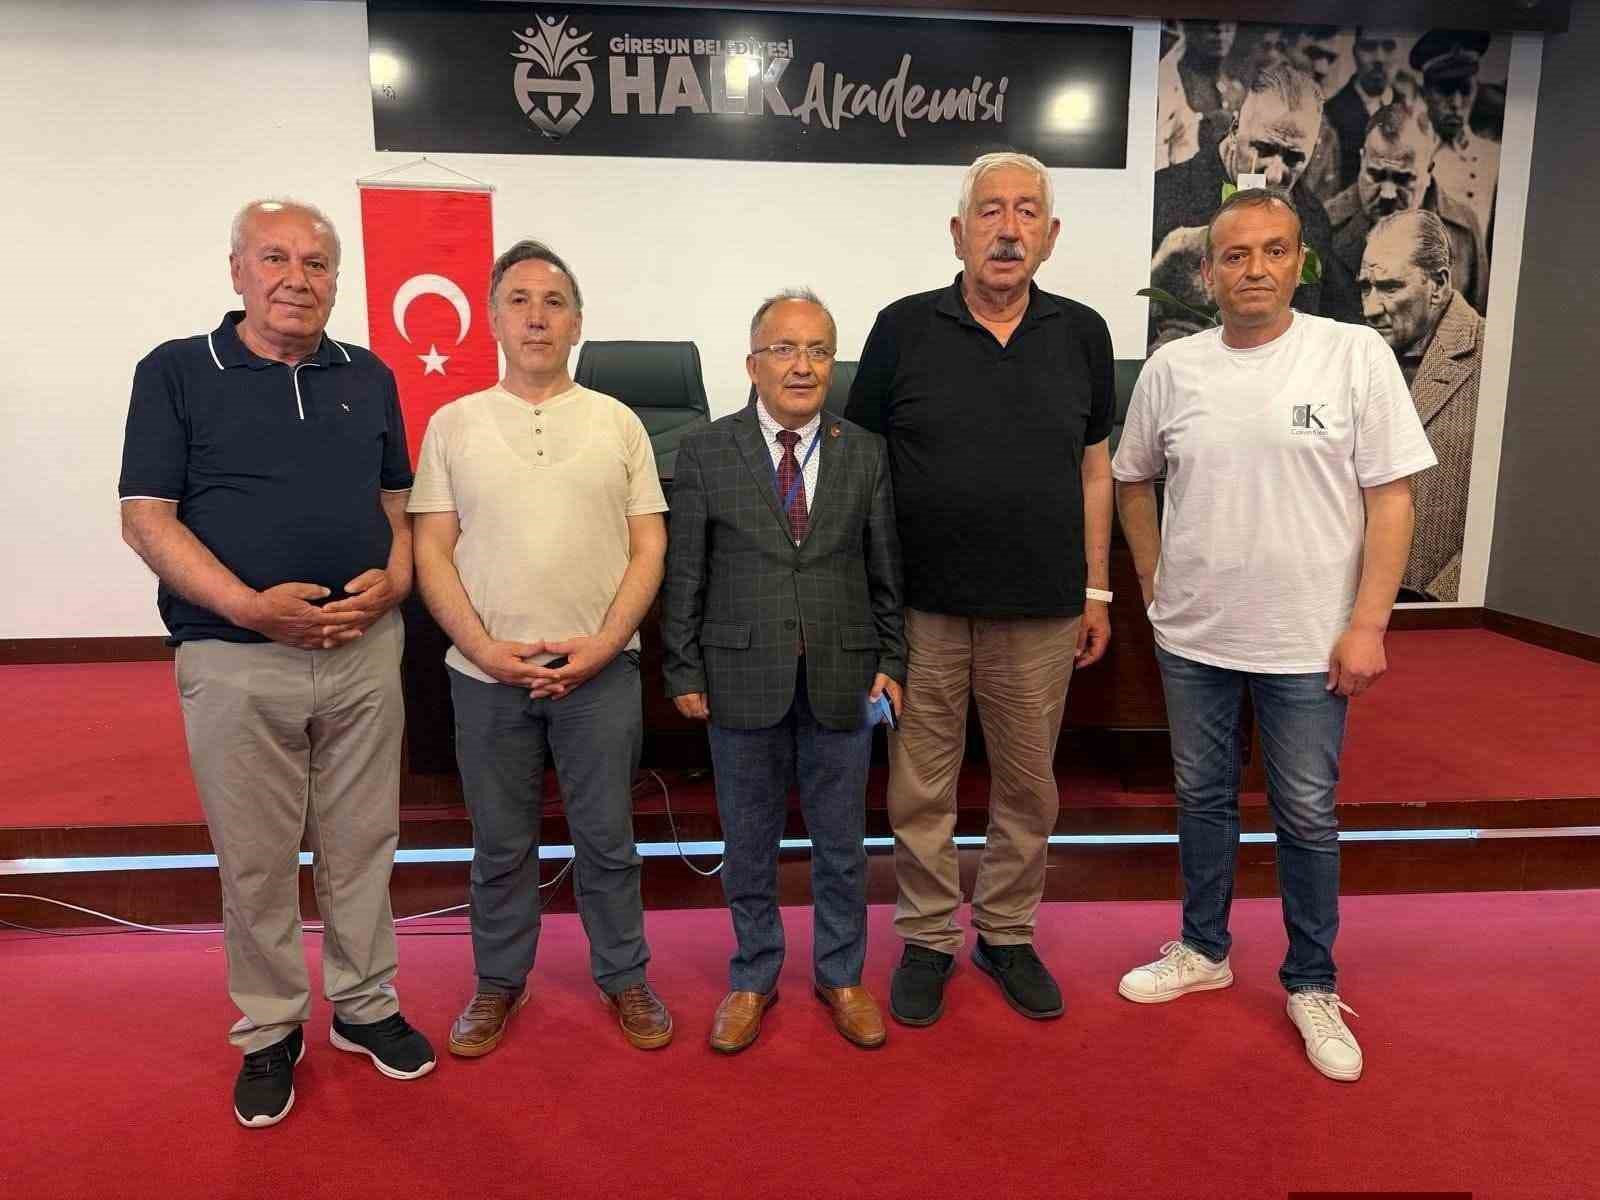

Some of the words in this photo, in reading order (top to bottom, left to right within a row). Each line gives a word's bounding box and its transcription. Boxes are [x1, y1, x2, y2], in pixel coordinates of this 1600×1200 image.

[609, 34, 690, 54] GİRESUN
[608, 55, 793, 115] HALK
[792, 53, 1009, 138] Akademisi
